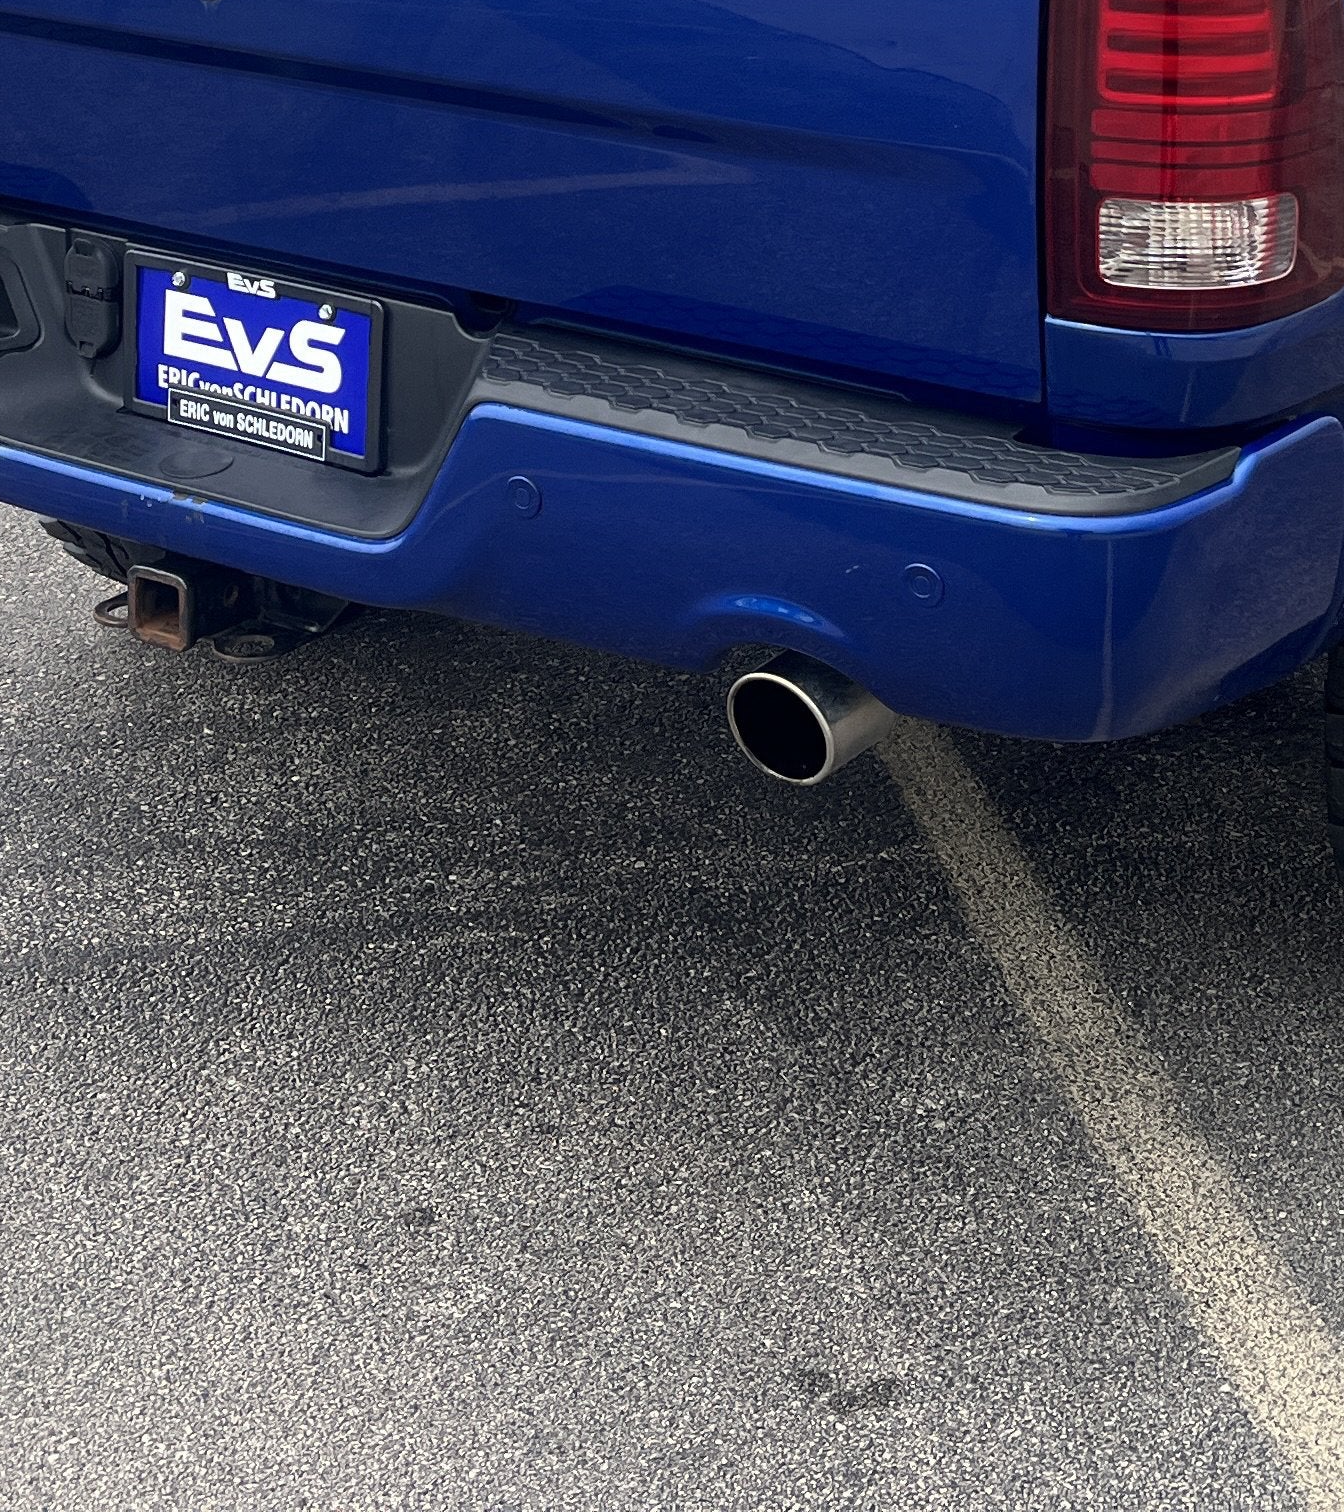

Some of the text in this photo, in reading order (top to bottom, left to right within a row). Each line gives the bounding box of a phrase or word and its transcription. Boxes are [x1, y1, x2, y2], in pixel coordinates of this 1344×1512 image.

[179, 399, 314, 450] ERIC von SCHLEDORN
